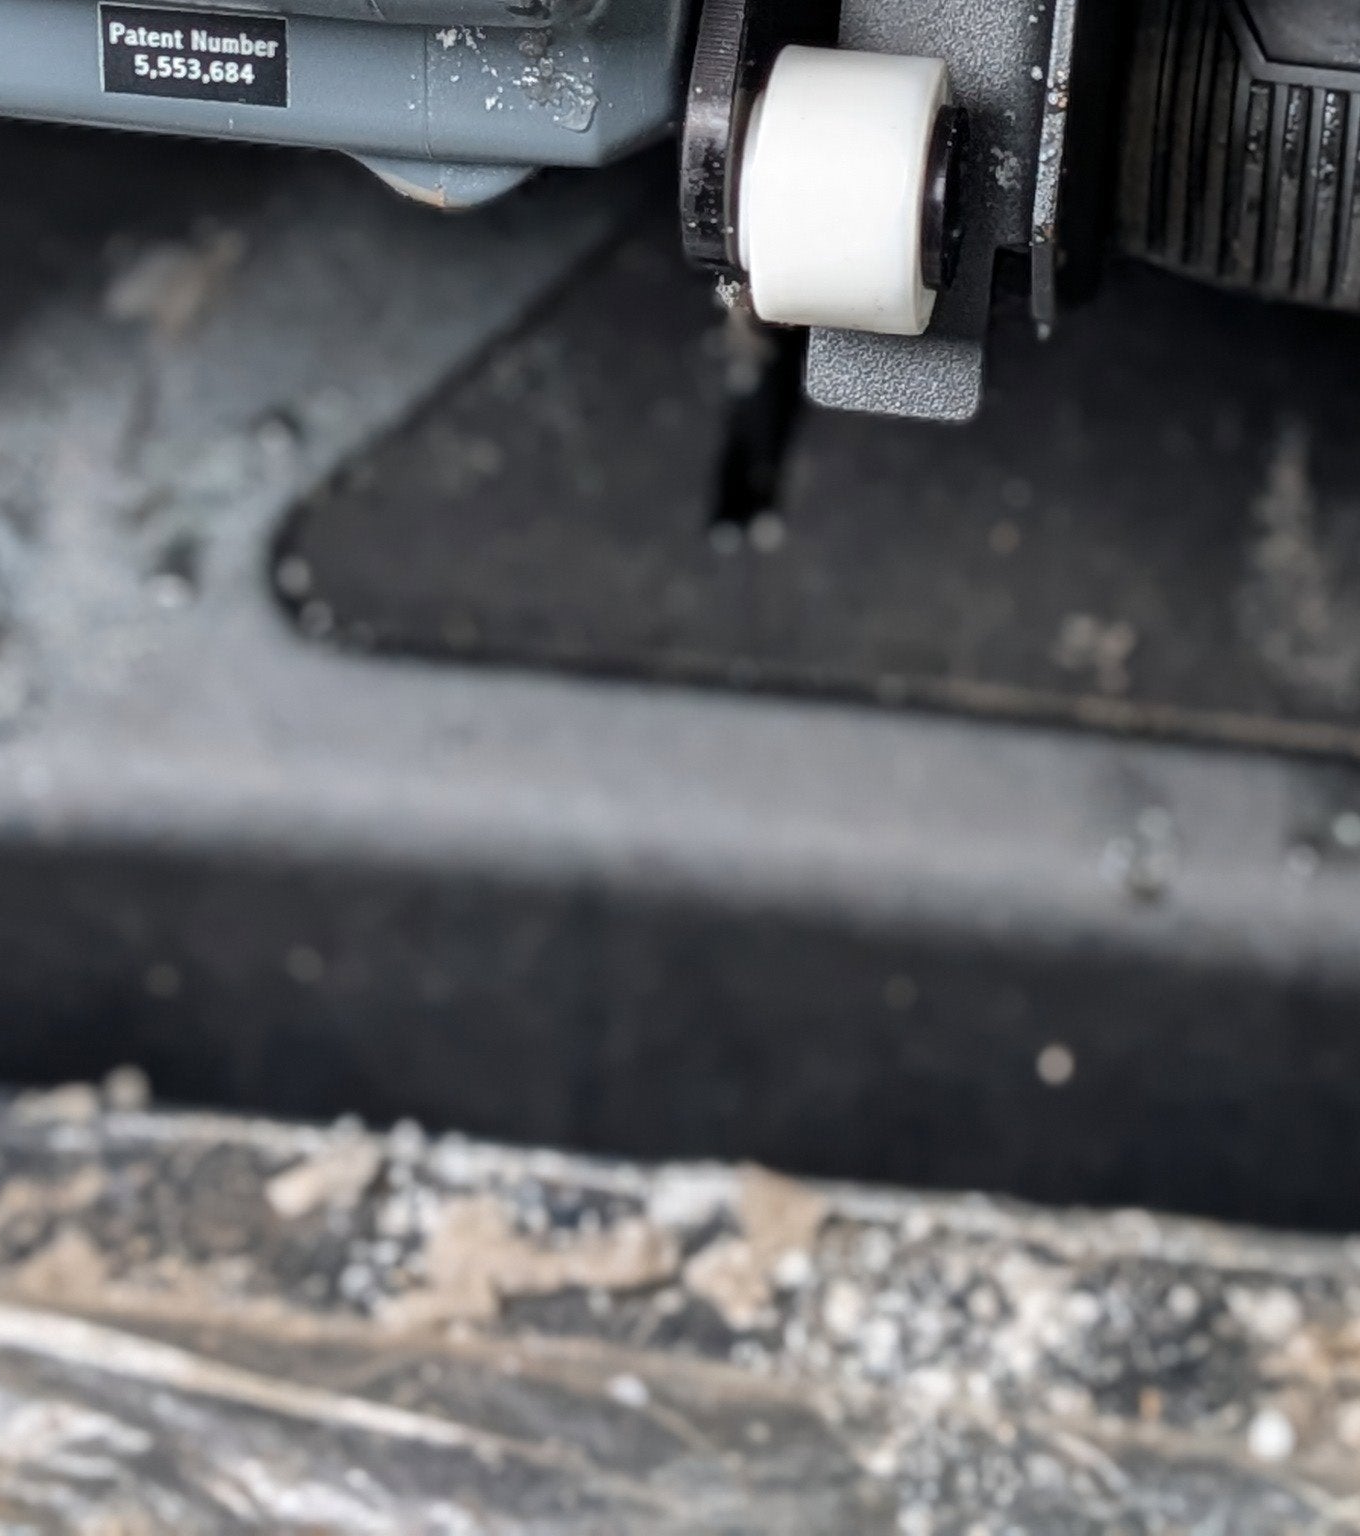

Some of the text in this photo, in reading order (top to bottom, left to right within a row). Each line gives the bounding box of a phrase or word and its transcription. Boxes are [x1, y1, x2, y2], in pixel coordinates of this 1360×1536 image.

[108, 21, 280, 58] Patent Number
[133, 53, 256, 86] 5,553,684
